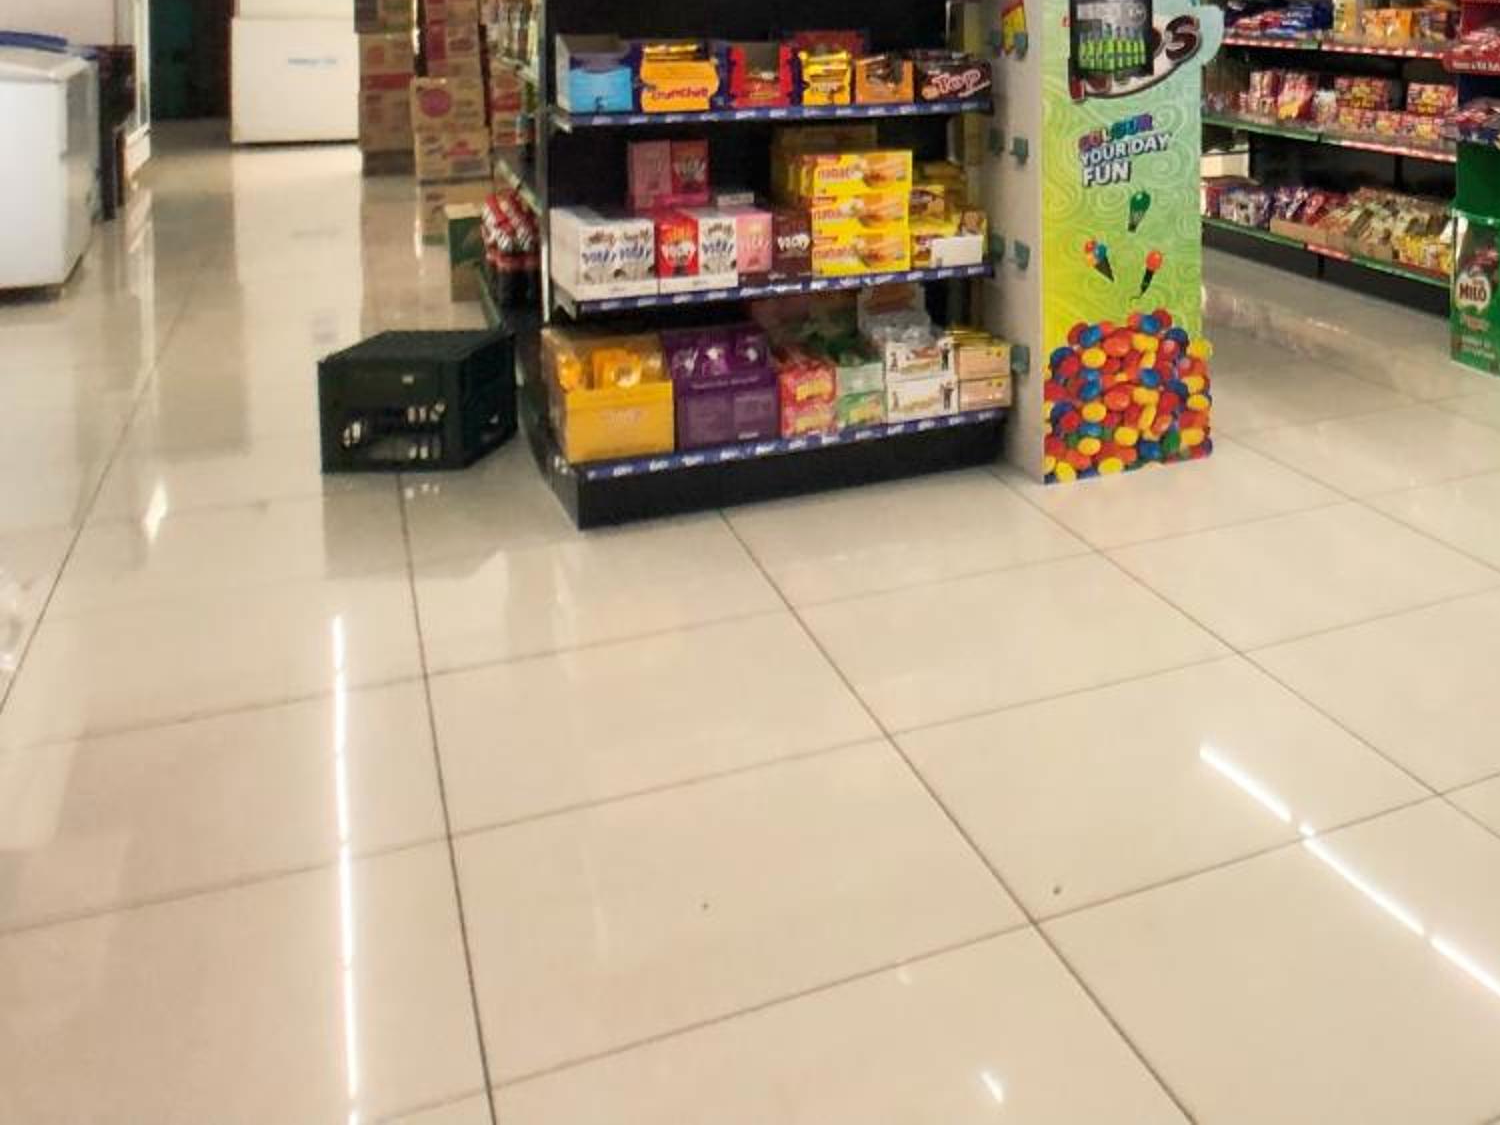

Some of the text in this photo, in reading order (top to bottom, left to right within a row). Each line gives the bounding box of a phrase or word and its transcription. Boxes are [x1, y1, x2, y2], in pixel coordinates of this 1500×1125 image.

[1079, 113, 1153, 152] COLOUR
[1081, 132, 1171, 167] YOUR DAY
[1083, 160, 1131, 187] FUN
[1459, 282, 1487, 303] MILO
